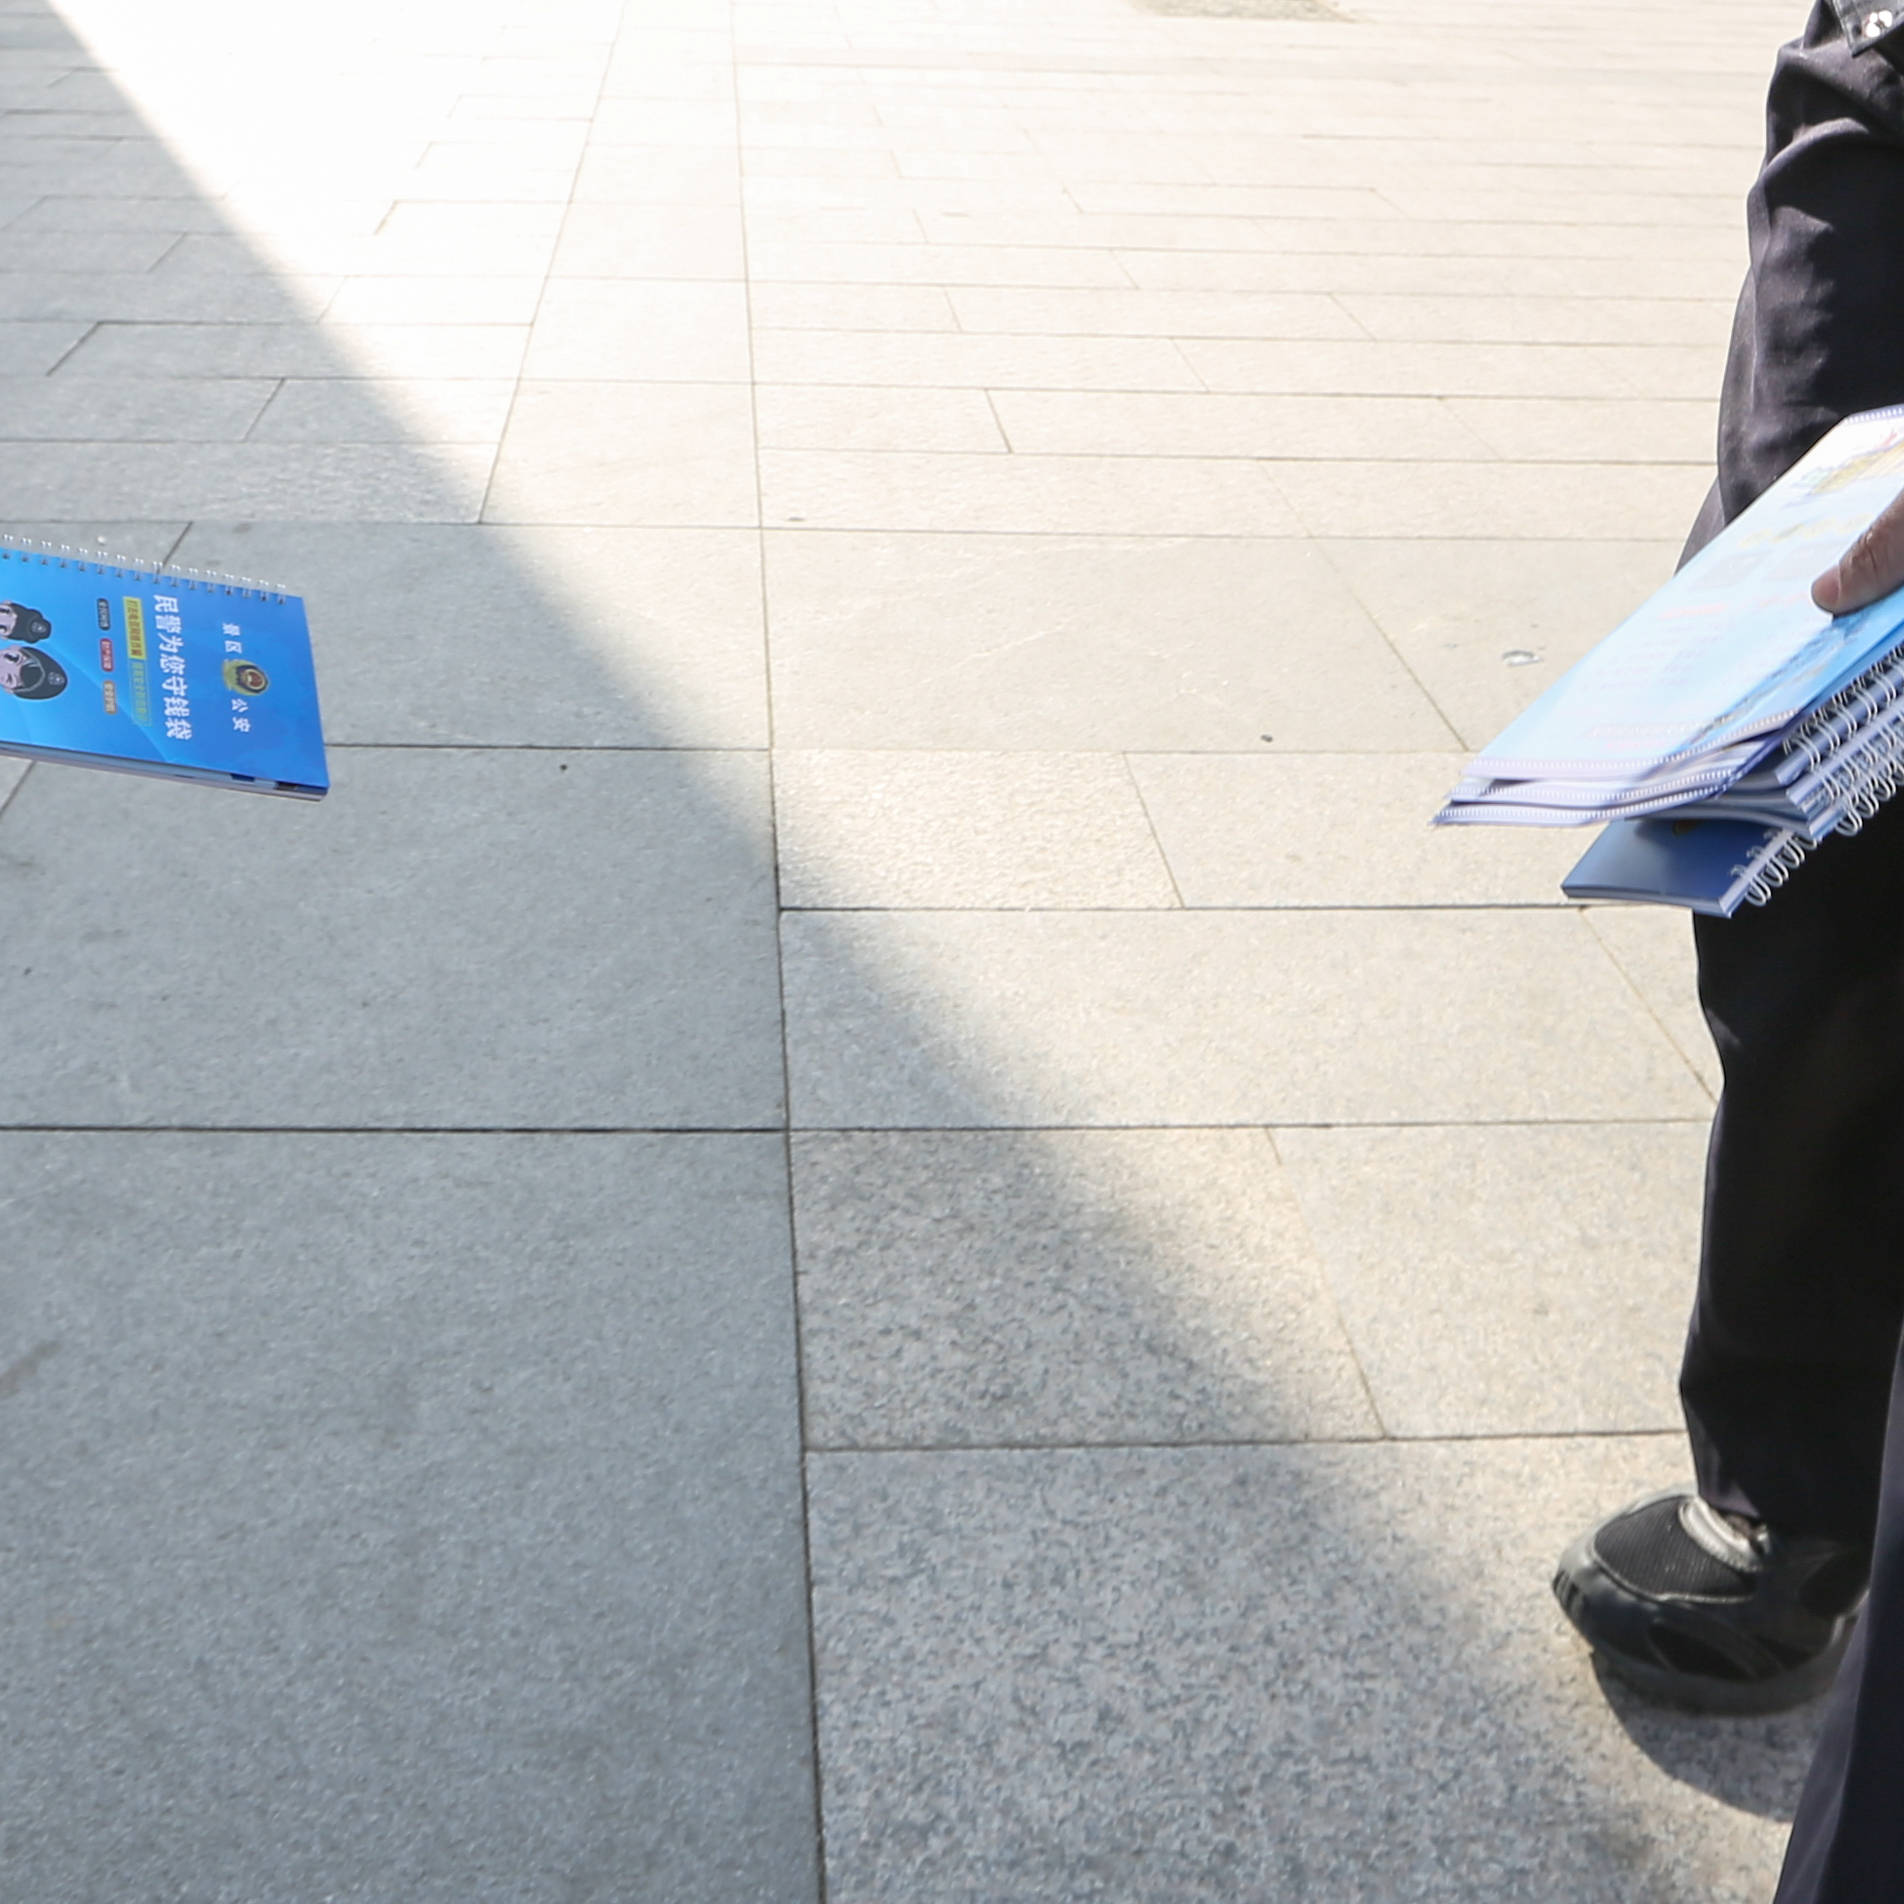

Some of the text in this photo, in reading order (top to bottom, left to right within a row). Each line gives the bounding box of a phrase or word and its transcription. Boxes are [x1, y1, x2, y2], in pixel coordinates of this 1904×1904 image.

[153, 594, 193, 740] 民警为您守钱袋
[222, 621, 252, 733] 景区 公安
